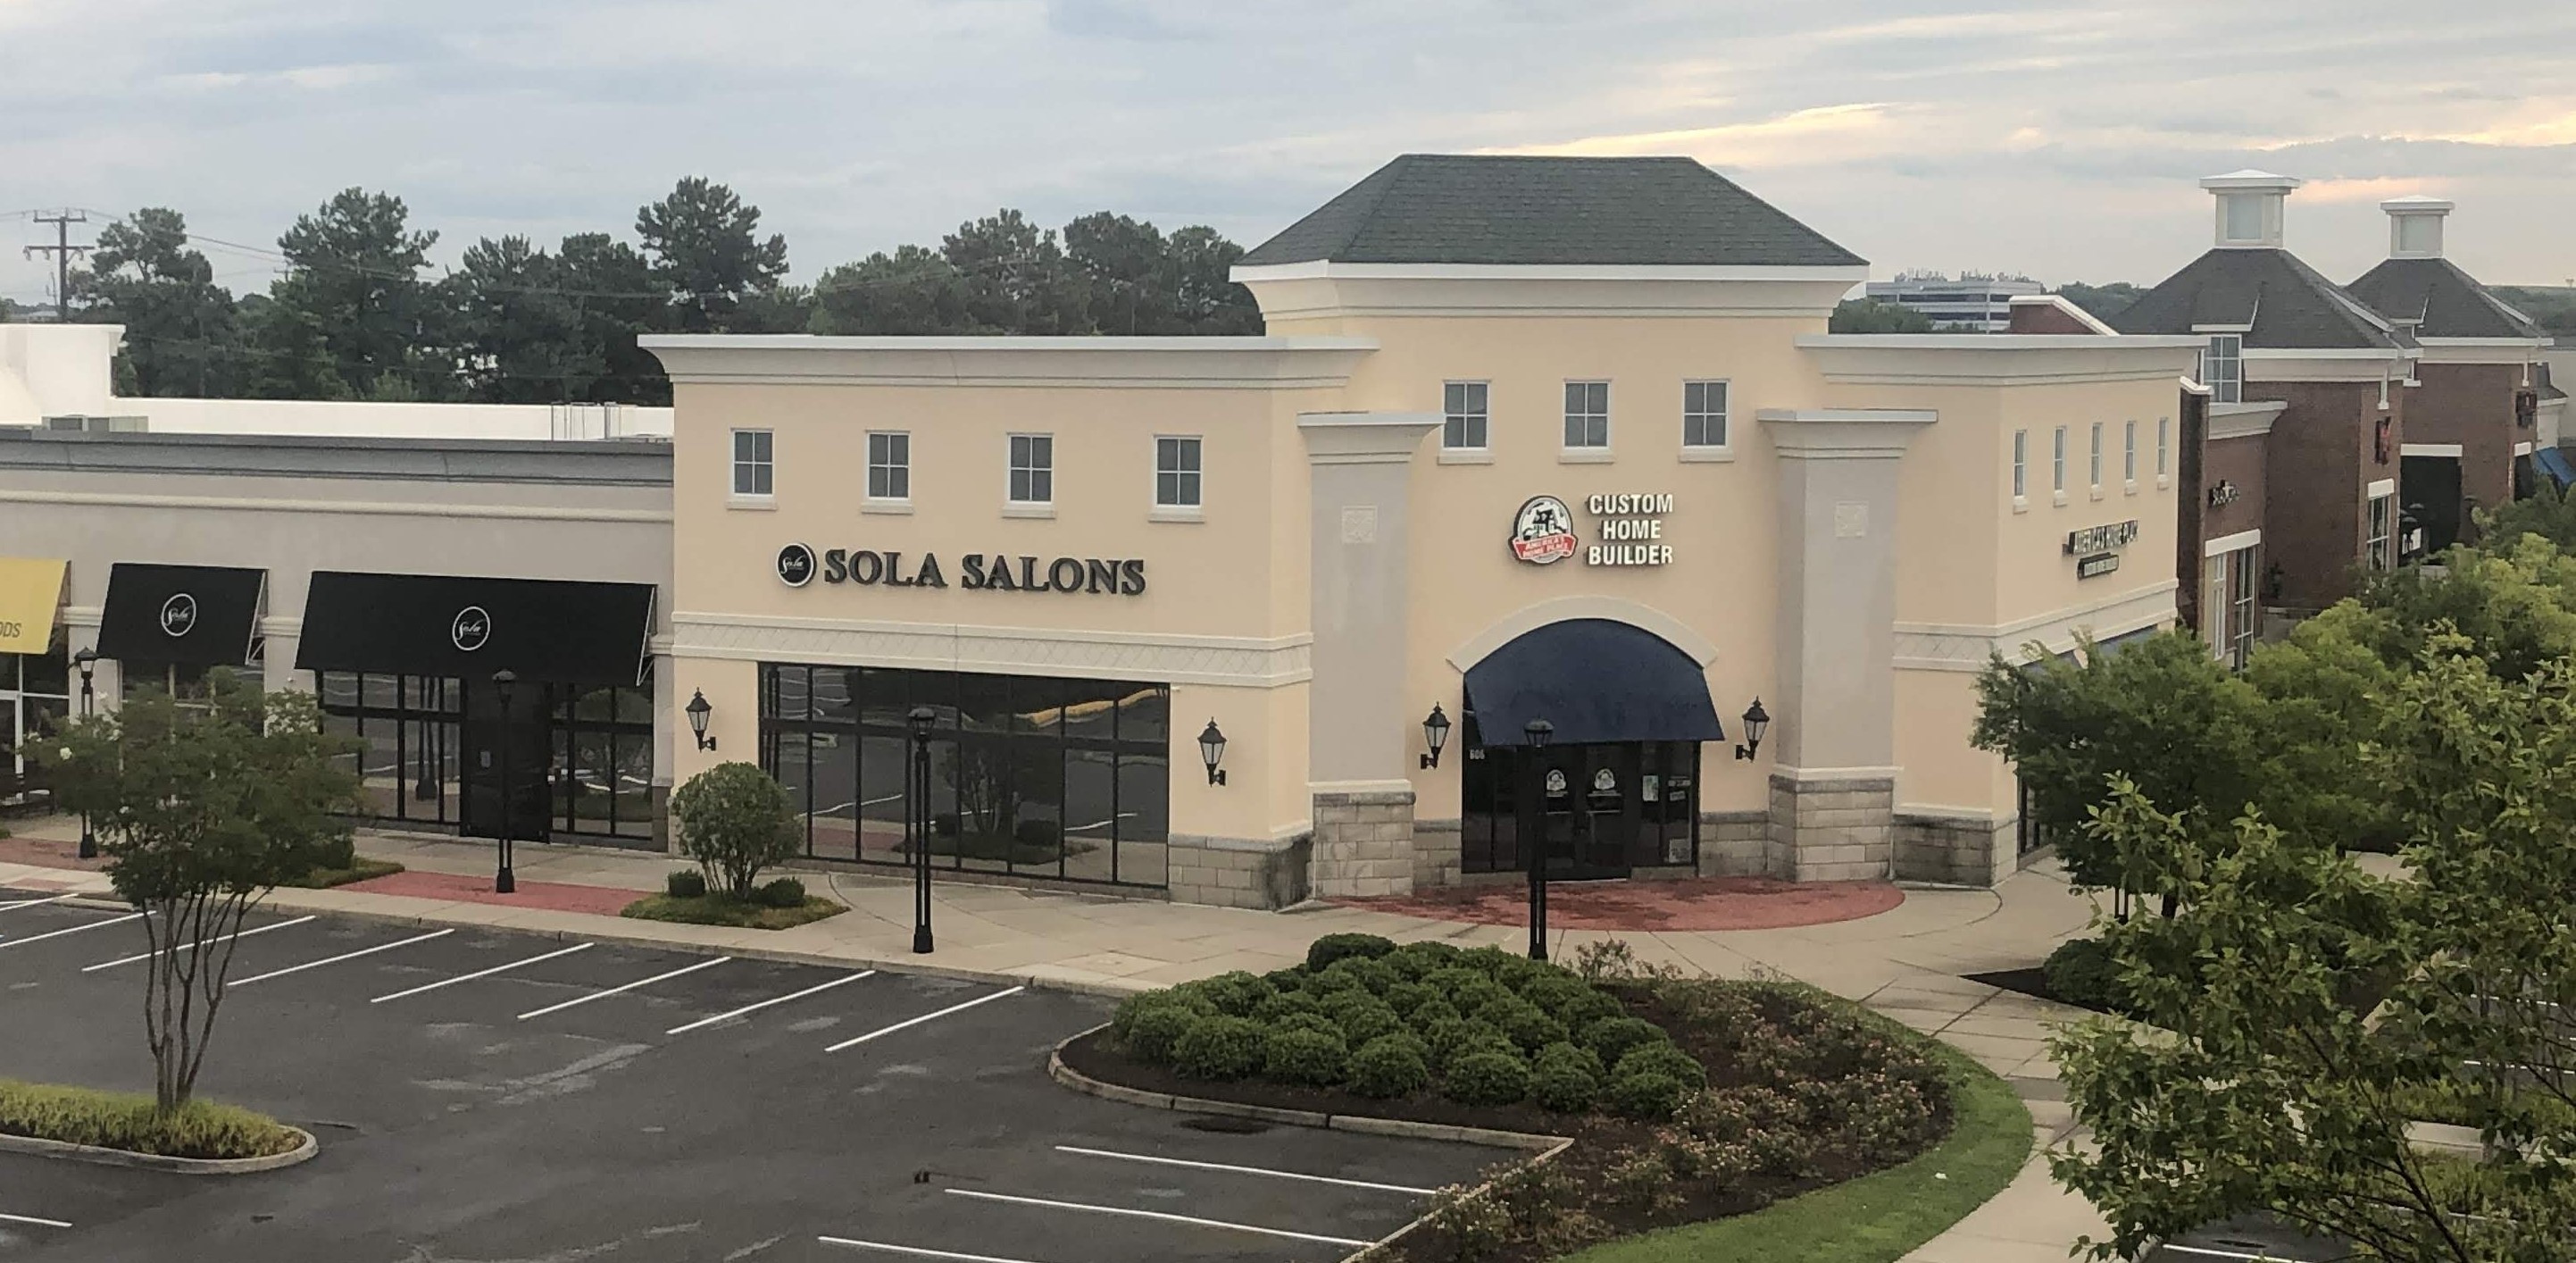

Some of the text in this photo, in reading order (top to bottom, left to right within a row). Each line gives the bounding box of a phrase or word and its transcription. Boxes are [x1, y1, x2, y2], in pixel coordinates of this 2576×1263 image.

[1588, 493, 1673, 514] CUSTOM
[1602, 519, 1662, 540] HOME
[1588, 544, 1673, 565] BUILDER
[824, 548, 1146, 596] SOLA SALONS
